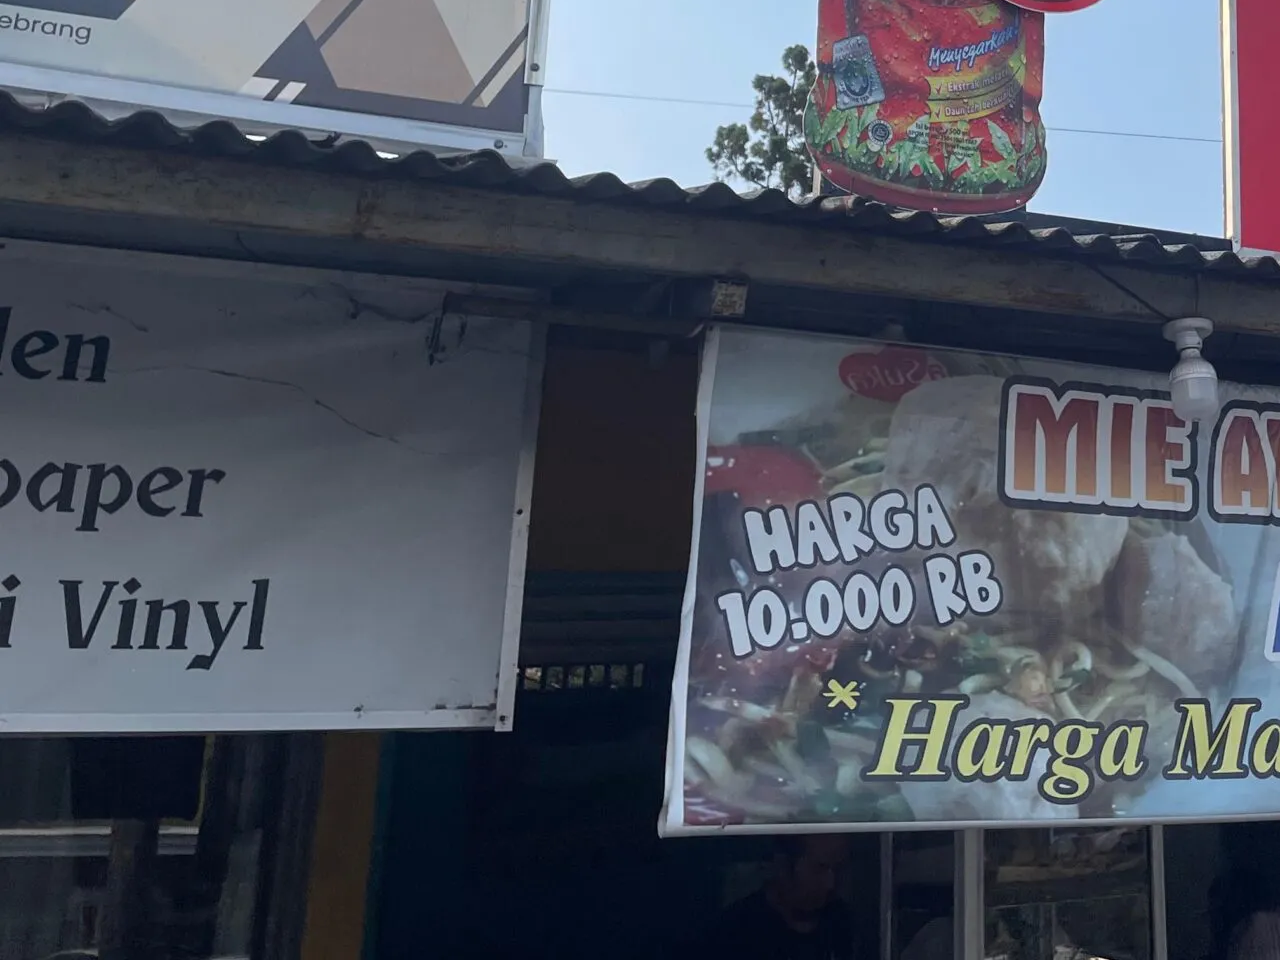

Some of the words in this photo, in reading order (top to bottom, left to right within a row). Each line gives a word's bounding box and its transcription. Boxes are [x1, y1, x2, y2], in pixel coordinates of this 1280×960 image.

[1006, 386, 1190, 510] MIE
[744, 486, 955, 573] HARGA
[59, 577, 270, 670] Vinyl
[717, 567, 914, 657] 10.000
[925, 553, 1001, 625] RB
[872, 699, 1143, 798] Harga
